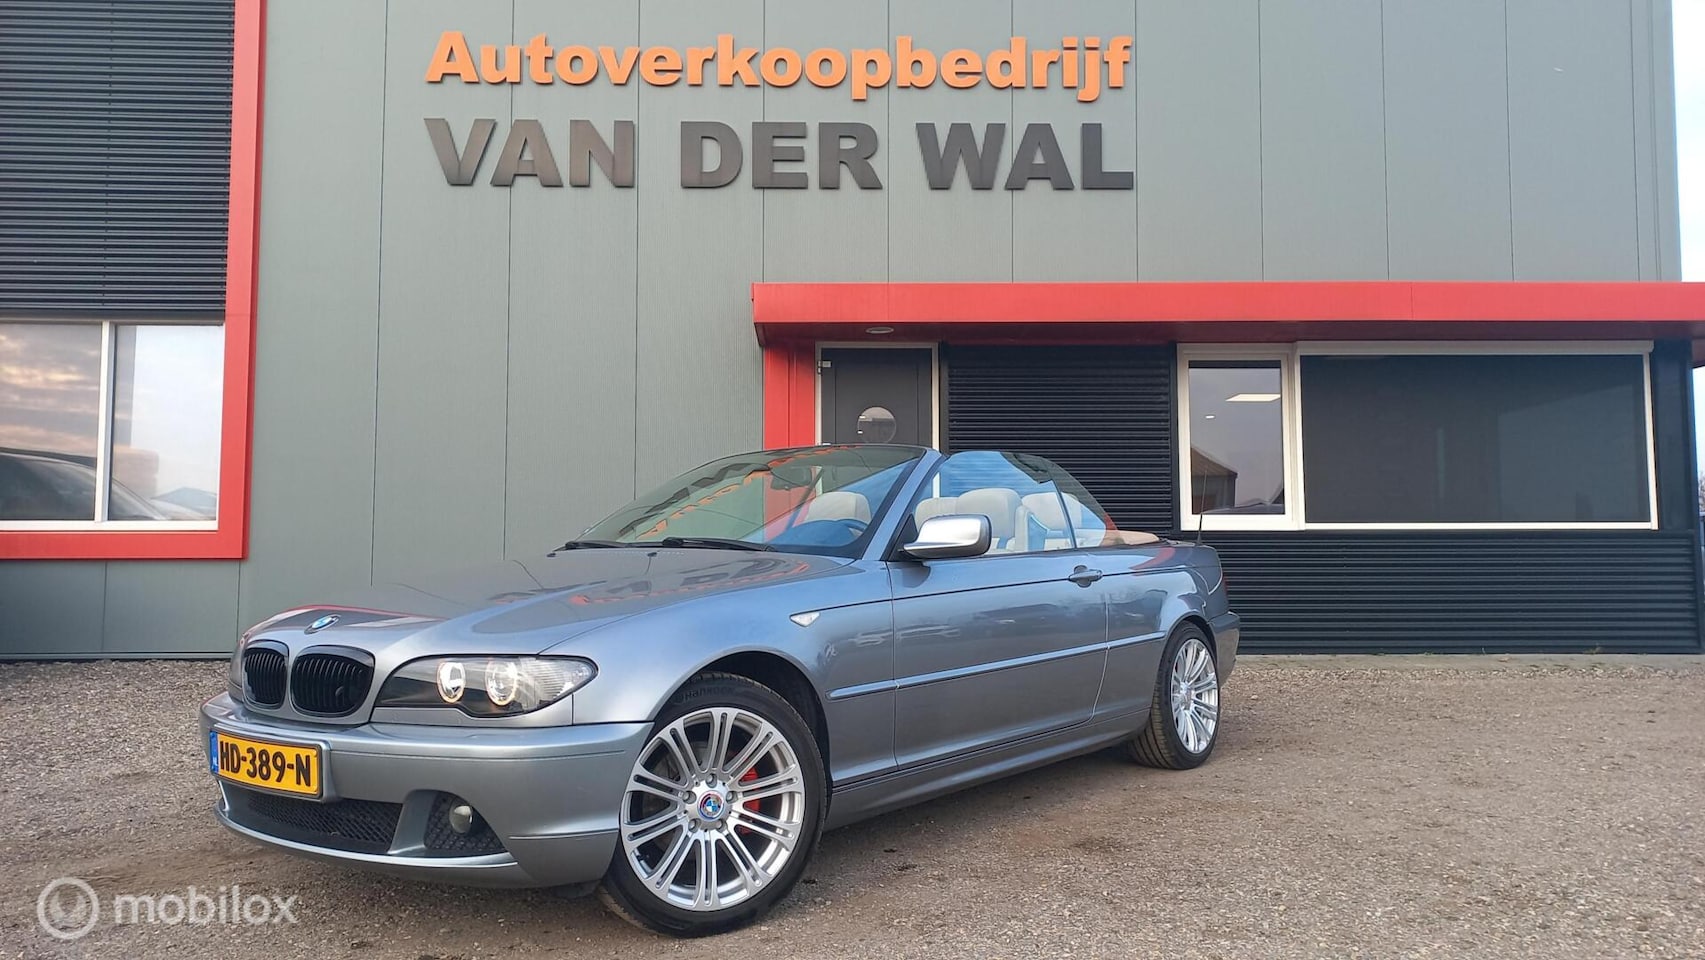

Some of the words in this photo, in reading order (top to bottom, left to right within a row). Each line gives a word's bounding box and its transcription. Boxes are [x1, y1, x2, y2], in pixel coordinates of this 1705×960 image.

[425, 31, 1133, 102] Autoverkoopbedrijf
[424, 118, 635, 188] VAN
[680, 121, 884, 190] DER
[915, 122, 1135, 191] WAL
[219, 740, 312, 787] HD-389-N
